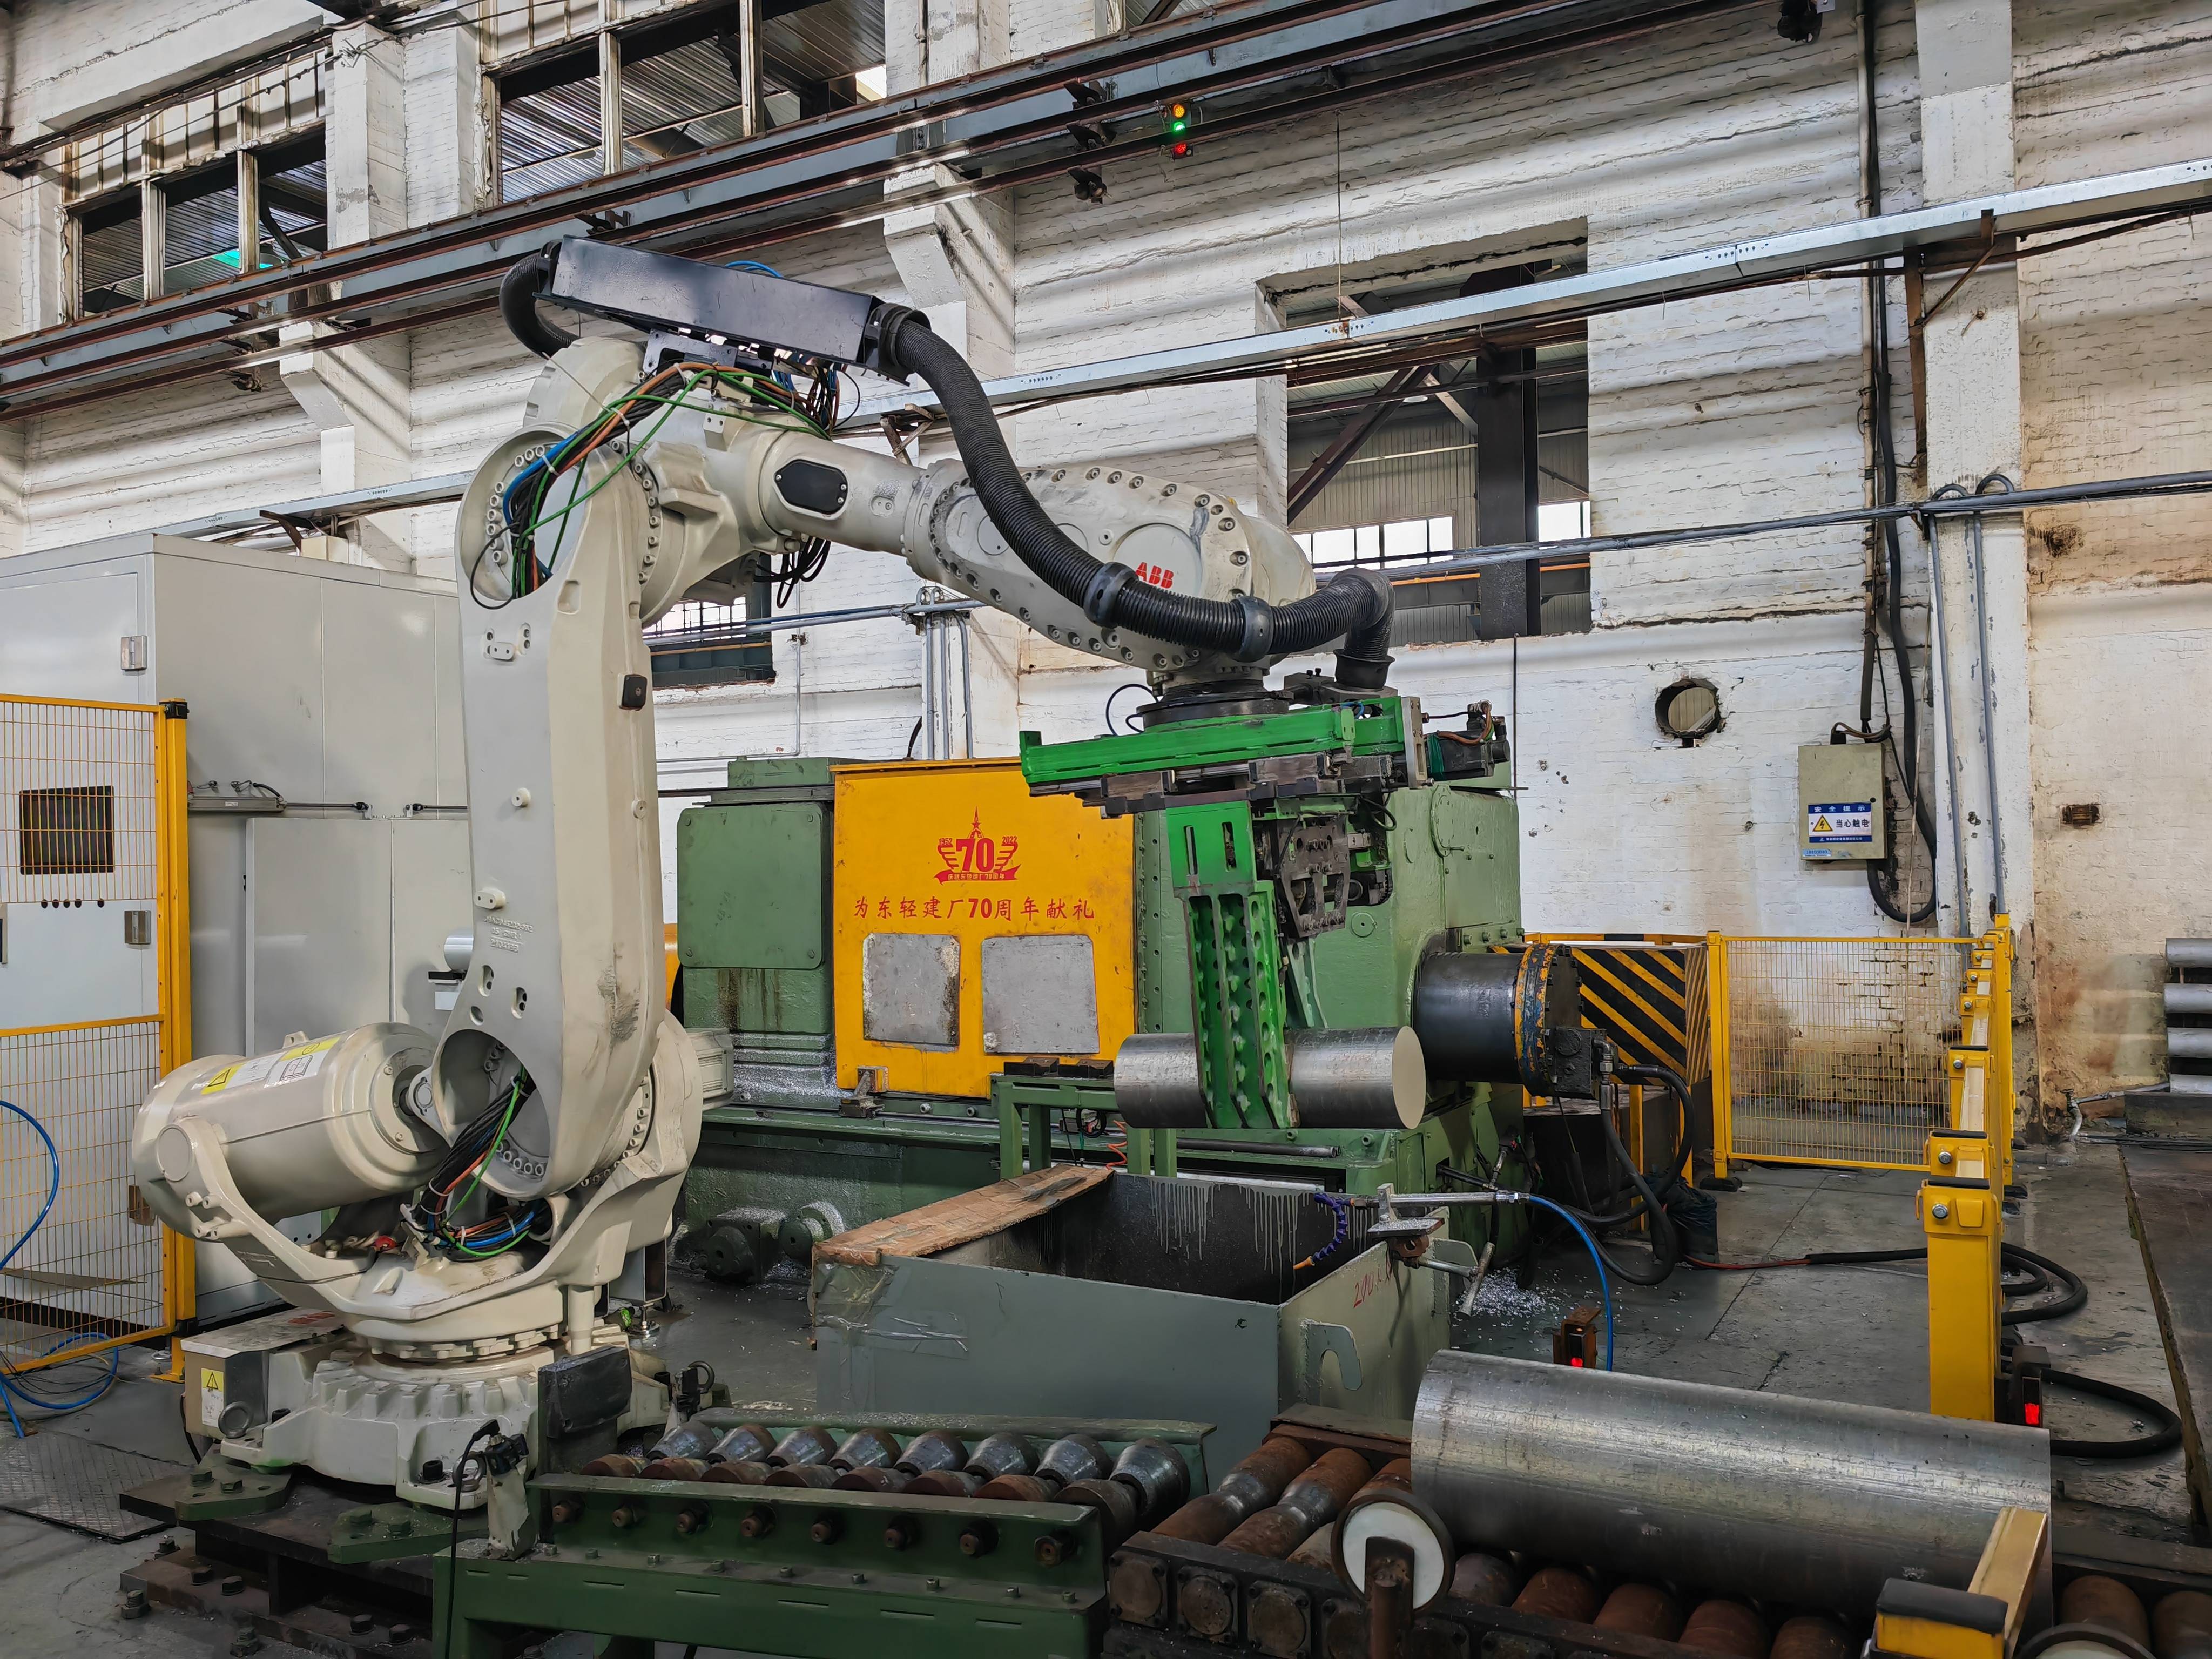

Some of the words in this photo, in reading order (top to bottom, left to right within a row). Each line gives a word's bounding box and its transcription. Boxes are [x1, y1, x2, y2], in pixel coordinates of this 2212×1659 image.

[1136, 562, 1174, 589] ABB
[1836, 819, 1870, 828] 当心触电
[956, 838, 994, 872] 70
[854, 896, 1095, 921] 为东轻建厂70周年献礼
